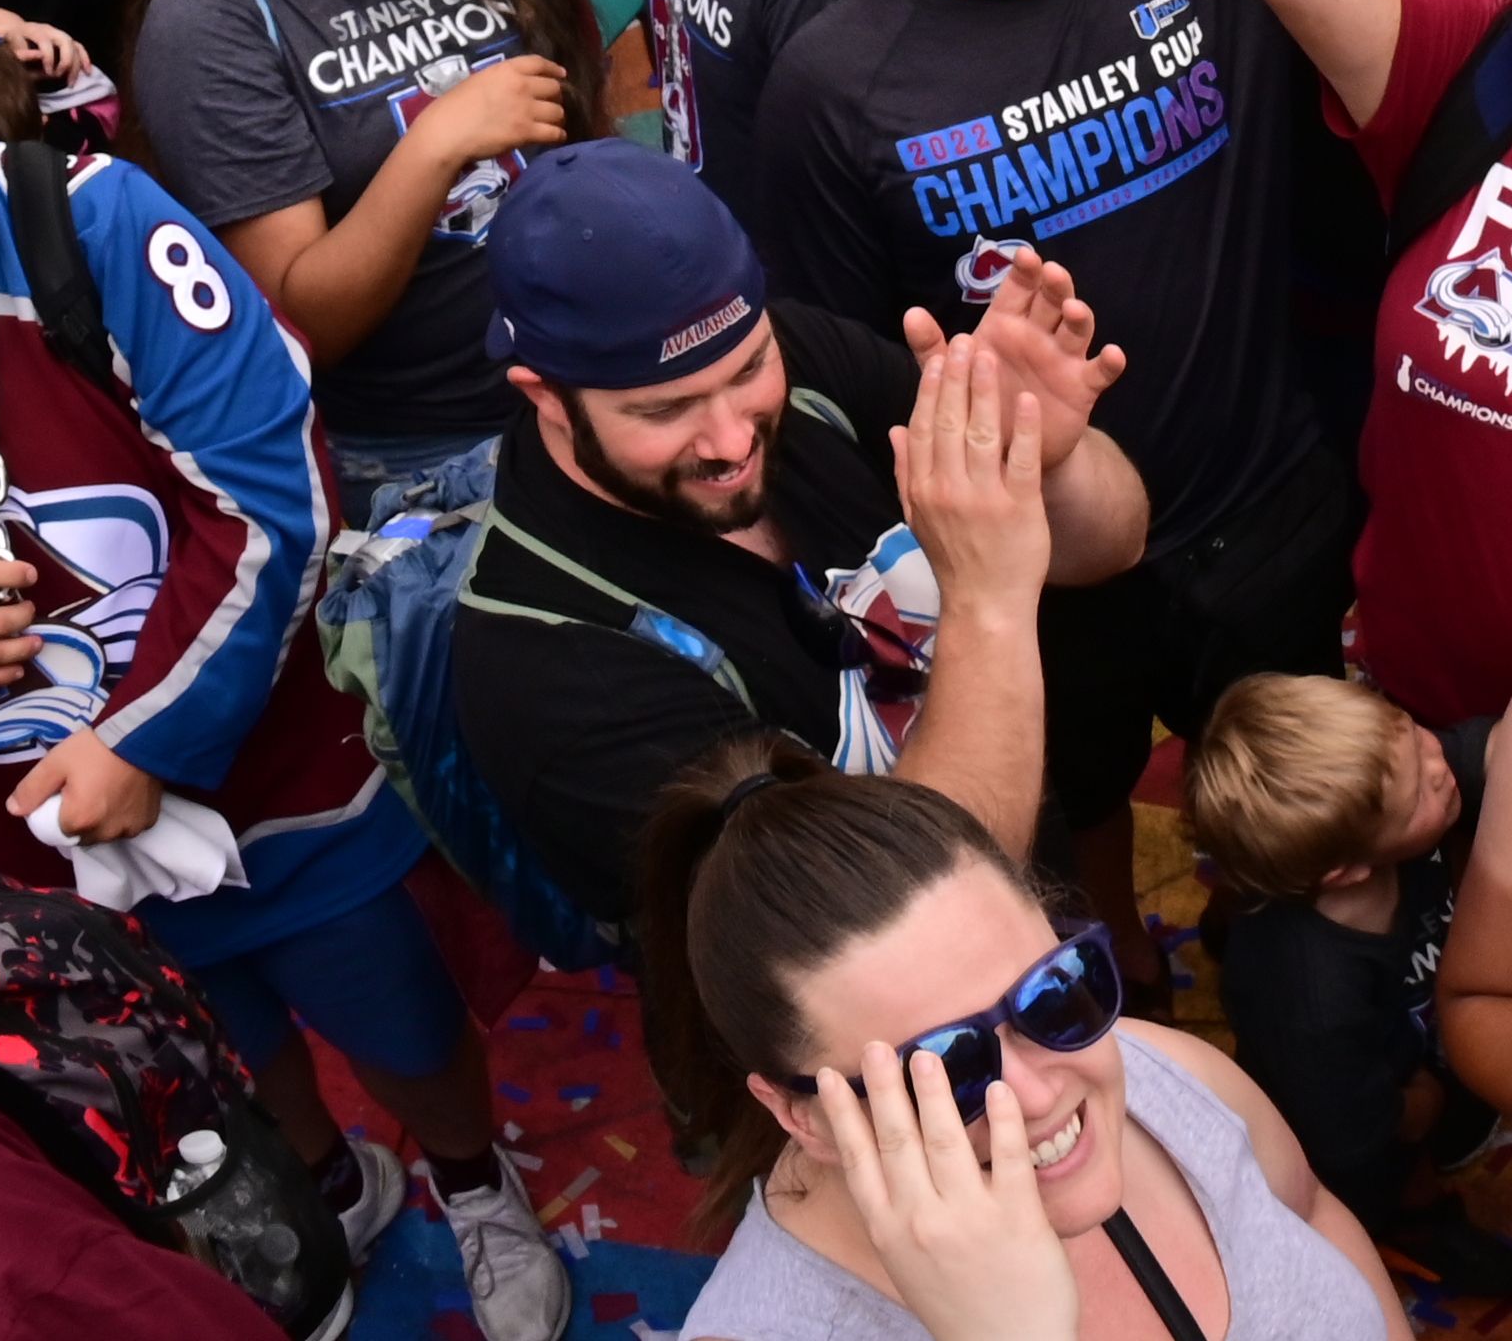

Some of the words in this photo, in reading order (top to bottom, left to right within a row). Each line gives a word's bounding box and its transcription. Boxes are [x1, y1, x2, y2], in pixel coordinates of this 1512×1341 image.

[1001, 56, 1141, 145] STANLEY
[1148, 17, 1205, 80] CUP
[906, 121, 994, 170] 2022
[911, 58, 1227, 238] CHAMPIONS
[147, 222, 232, 331] 8
[658, 294, 752, 365] AVALANCHE
